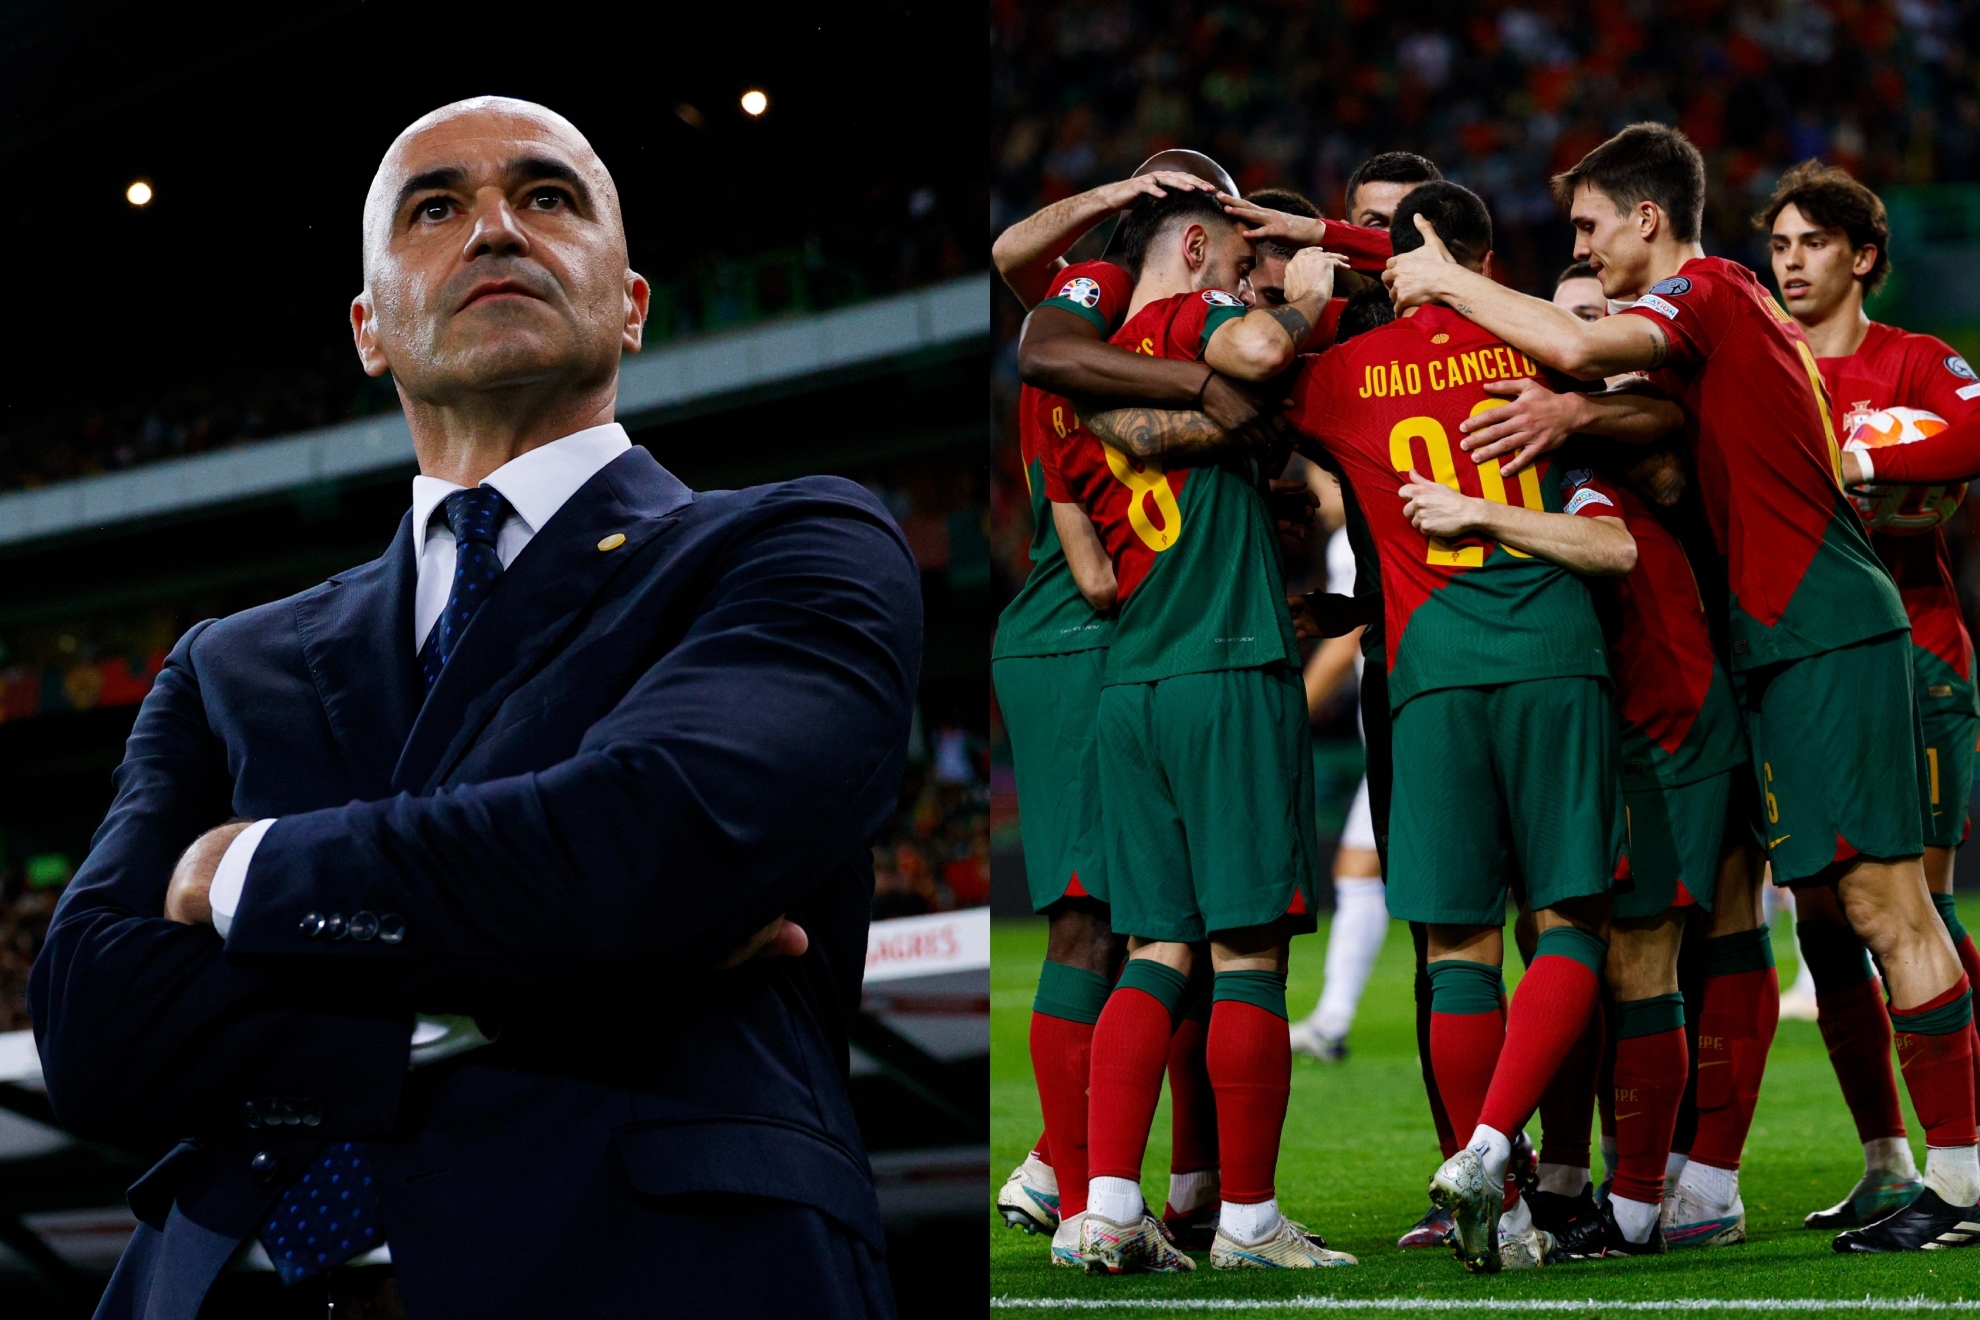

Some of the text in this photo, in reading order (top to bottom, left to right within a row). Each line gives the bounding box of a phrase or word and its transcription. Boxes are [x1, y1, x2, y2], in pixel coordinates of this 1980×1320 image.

[1359, 347, 1537, 399] JOÃO CANCELO
[1101, 440, 1182, 553] 8
[1389, 398, 1546, 568] 20
[1764, 762, 1779, 824] 6
